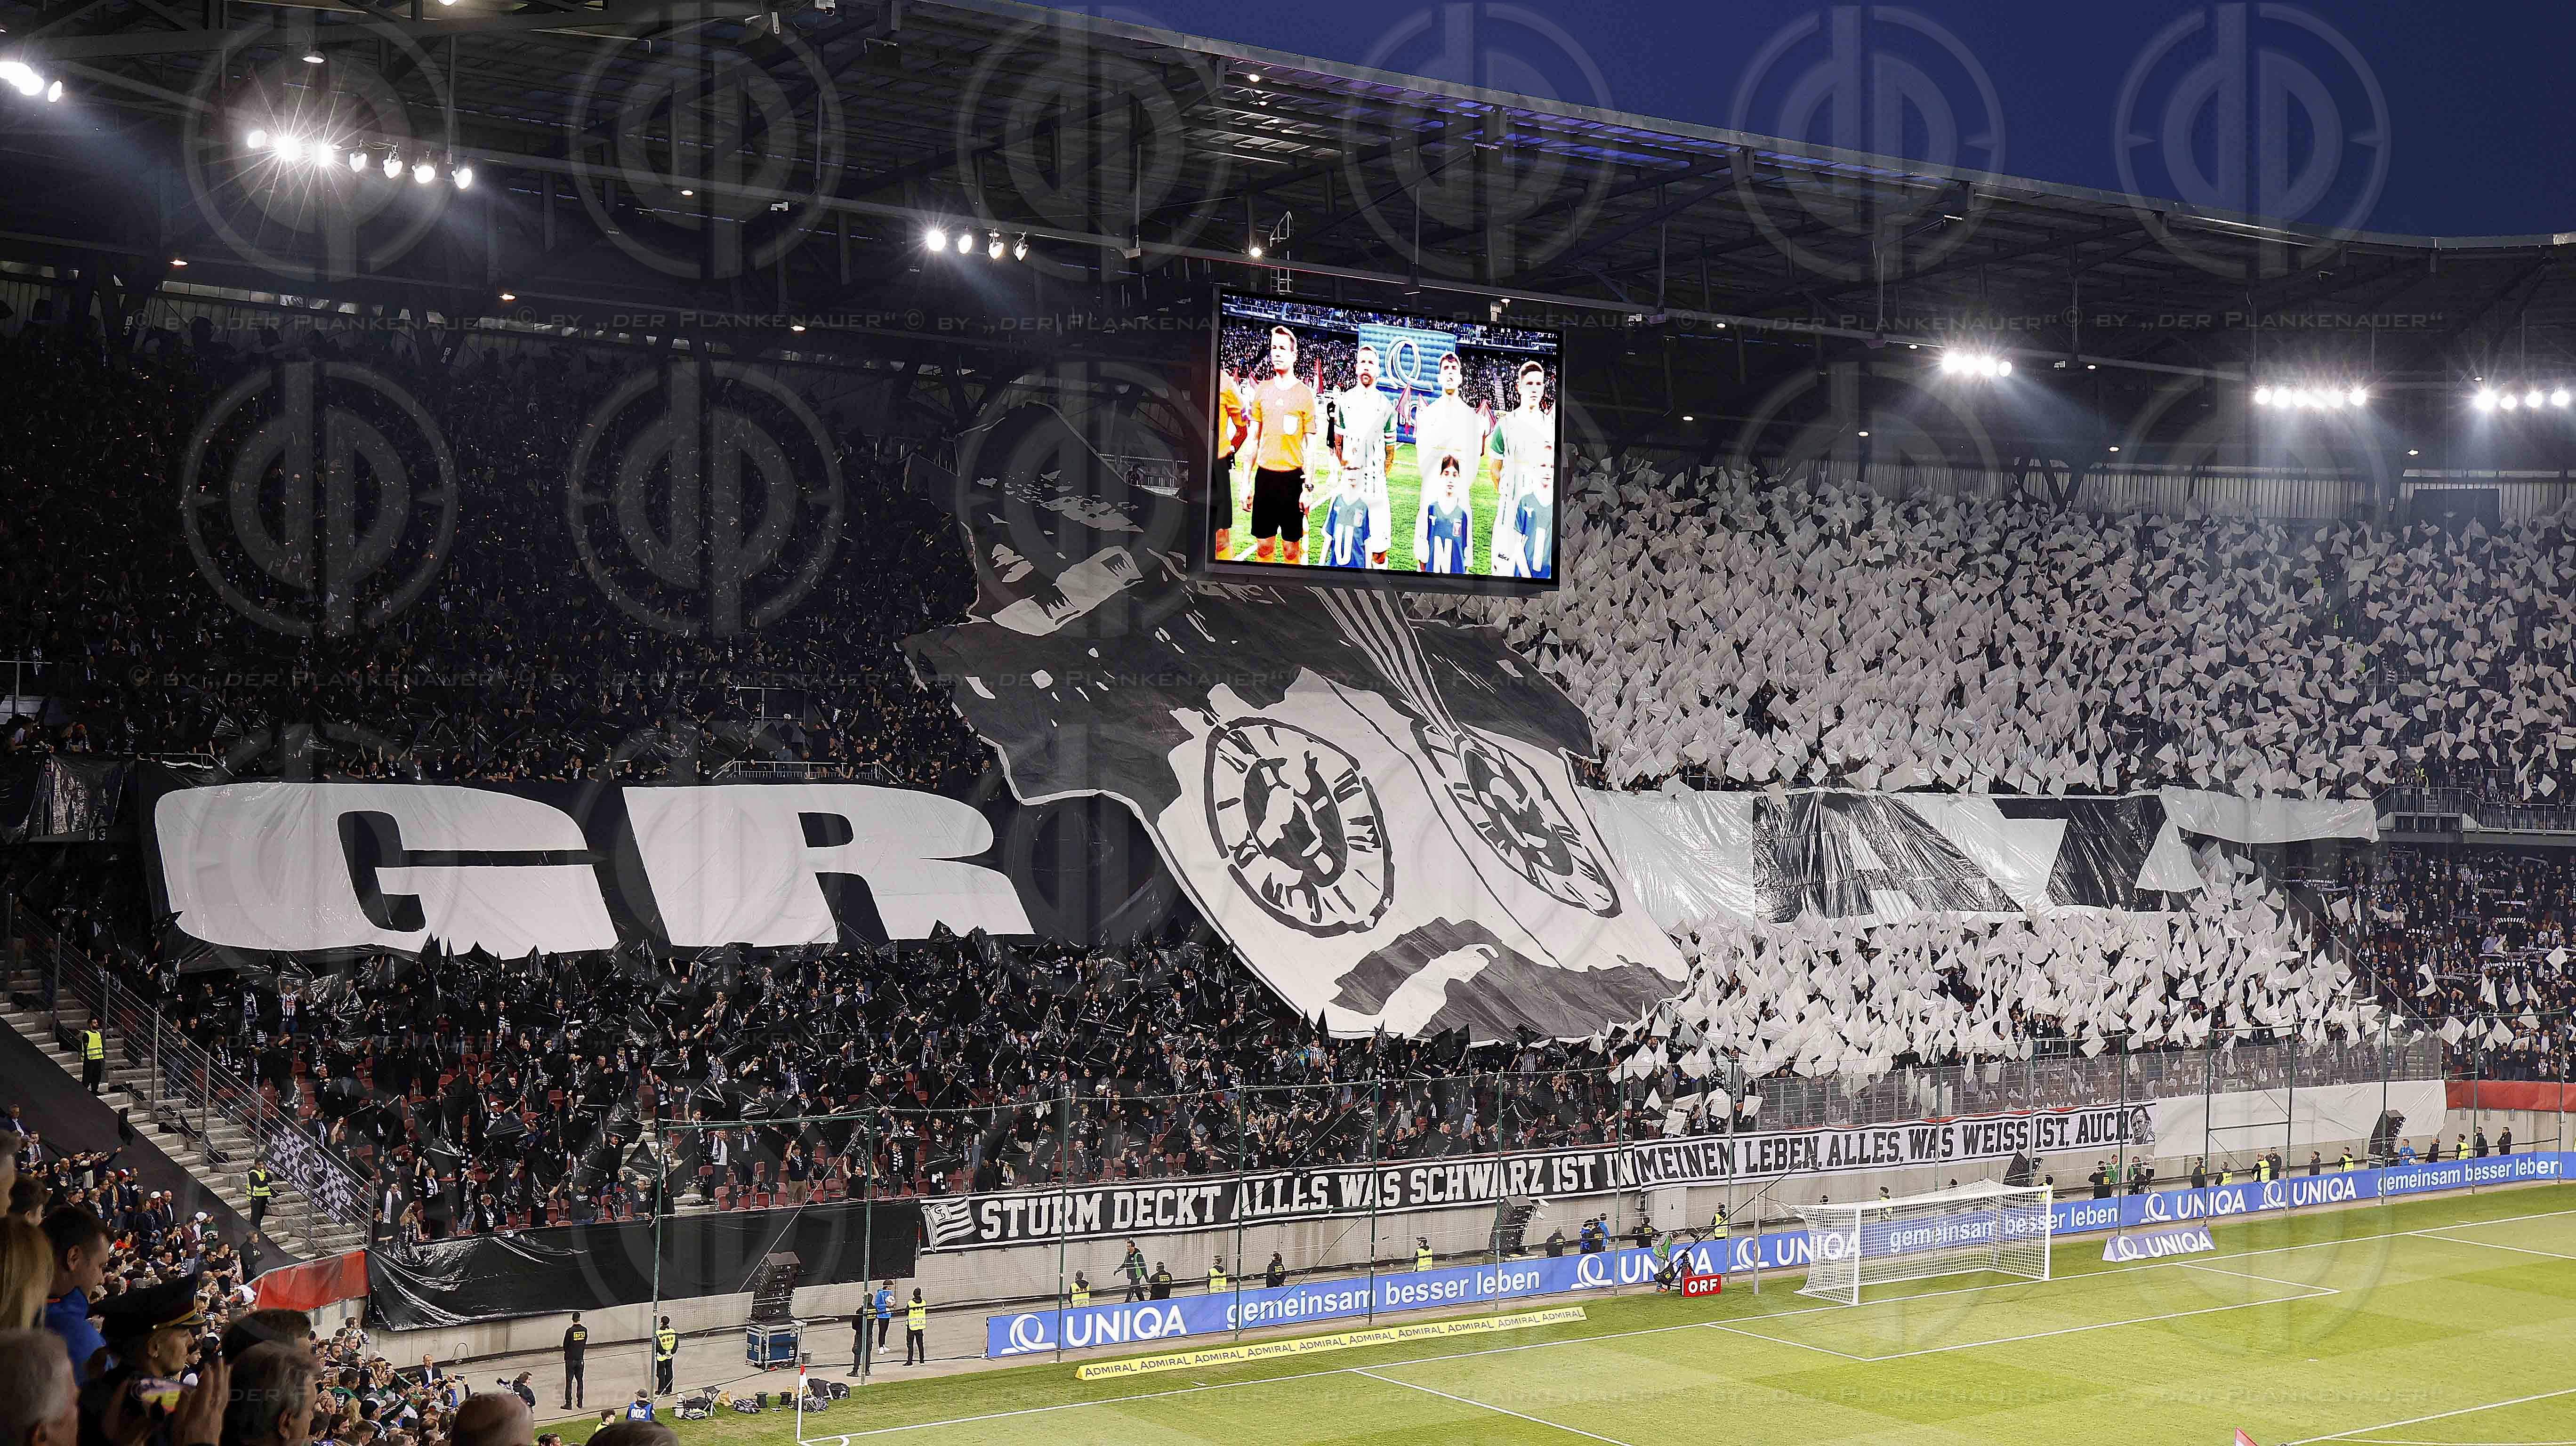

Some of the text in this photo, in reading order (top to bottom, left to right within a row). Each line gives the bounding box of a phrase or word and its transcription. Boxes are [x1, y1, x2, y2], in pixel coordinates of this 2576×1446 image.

[981, 1193, 1103, 1239] STURM
[1111, 1186, 1221, 1229] DECKT
[1339, 1171, 1402, 1208] WAS
[1410, 1158, 1544, 1204] SCHWARZ
[1552, 1155, 1595, 1192] IST
[1604, 1151, 1636, 1187] IN
[1908, 1127, 1953, 1159] WAS
[1963, 1121, 2029, 1153] WEISS
[2293, 1177, 2357, 1205] UNIQA
[2377, 1167, 2461, 1197] gemeinsam
[2465, 1162, 2512, 1182] besser
[2071, 1205, 2118, 1227] leben
[2177, 1189, 2246, 1219] UNIQA
[1776, 1230, 1861, 1265] UNIQA
[2145, 1231, 2215, 1258] UNIQA
[1226, 1269, 1541, 1330] gemeinsam besser leben
[1688, 1278, 1718, 1293] ORF
[1066, 1305, 1187, 1347] UNIQA
[1086, 1309, 1585, 1377] ADMIRAL ADMIRAL ADMIRAL ADMIRAL ADMIRAL ADMIRAL ADMIRAL ADMIRAL ADMIRAL ADMIRAL
[631, 1409, 646, 1419] 002
